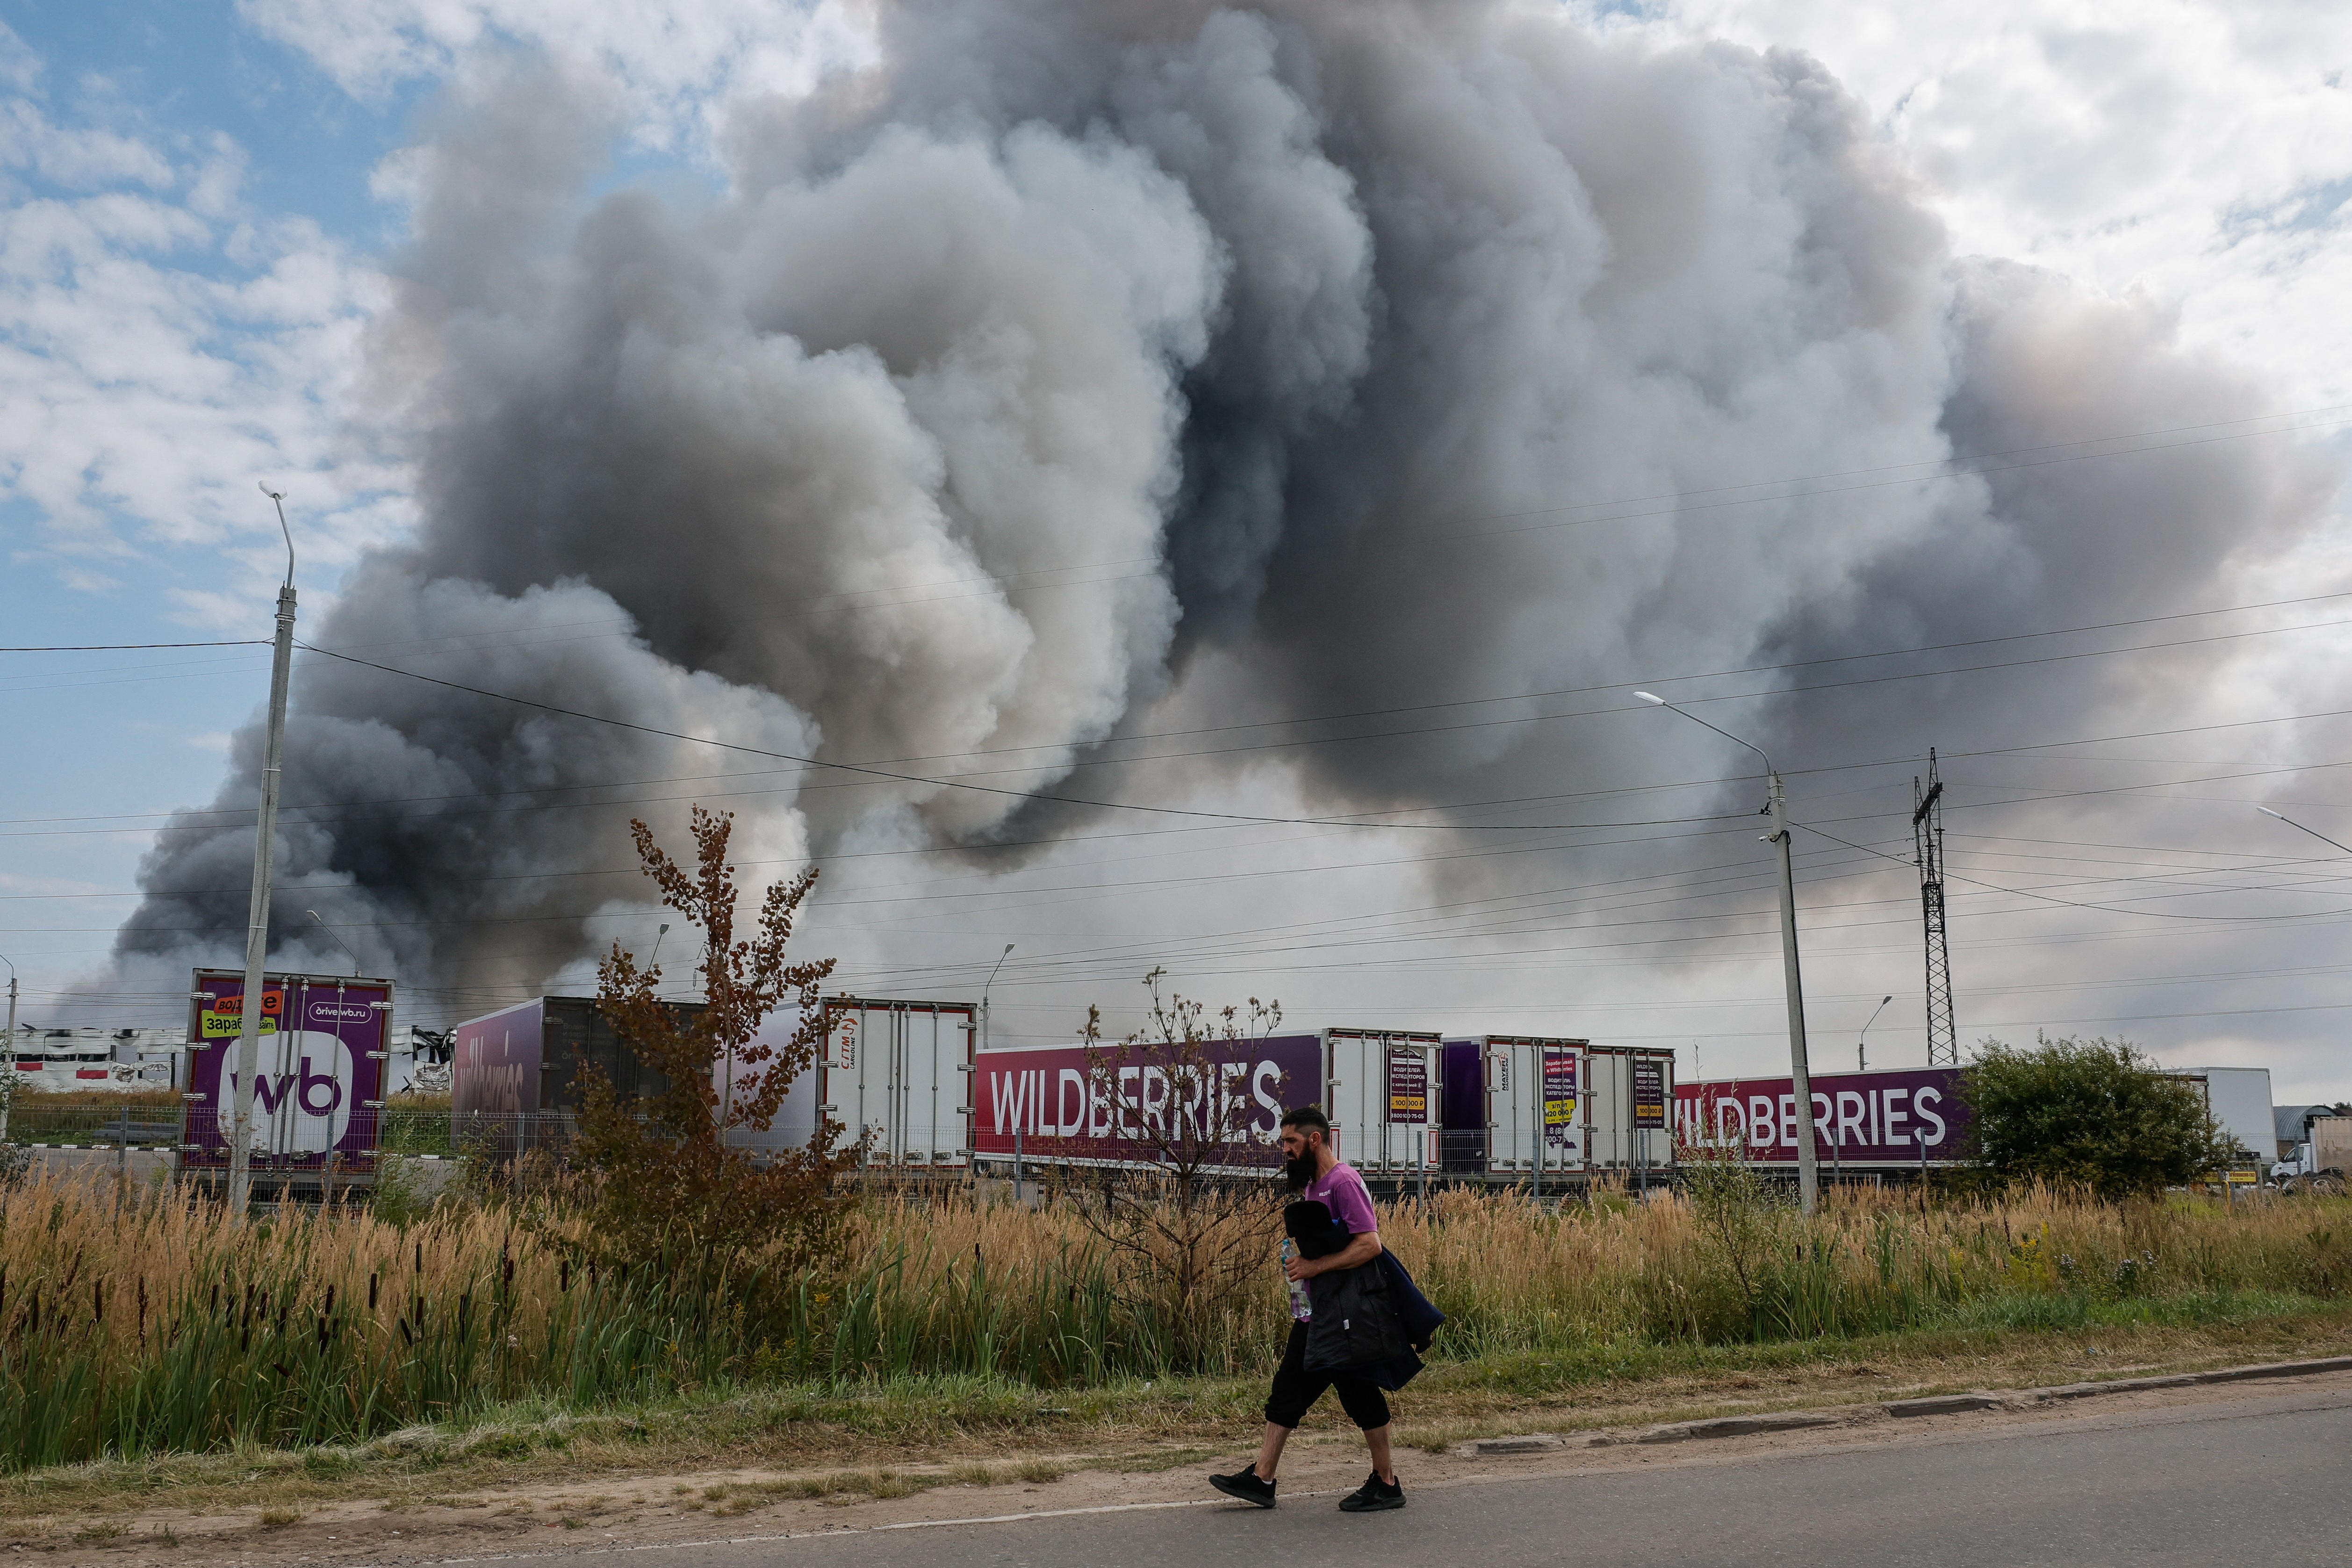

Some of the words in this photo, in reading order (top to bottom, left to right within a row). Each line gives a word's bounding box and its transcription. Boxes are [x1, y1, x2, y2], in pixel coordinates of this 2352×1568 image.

[218, 996, 277, 1012] воде
[207, 1018, 274, 1033] зарабвайте
[990, 1060, 1283, 1145] WILDBERRIES
